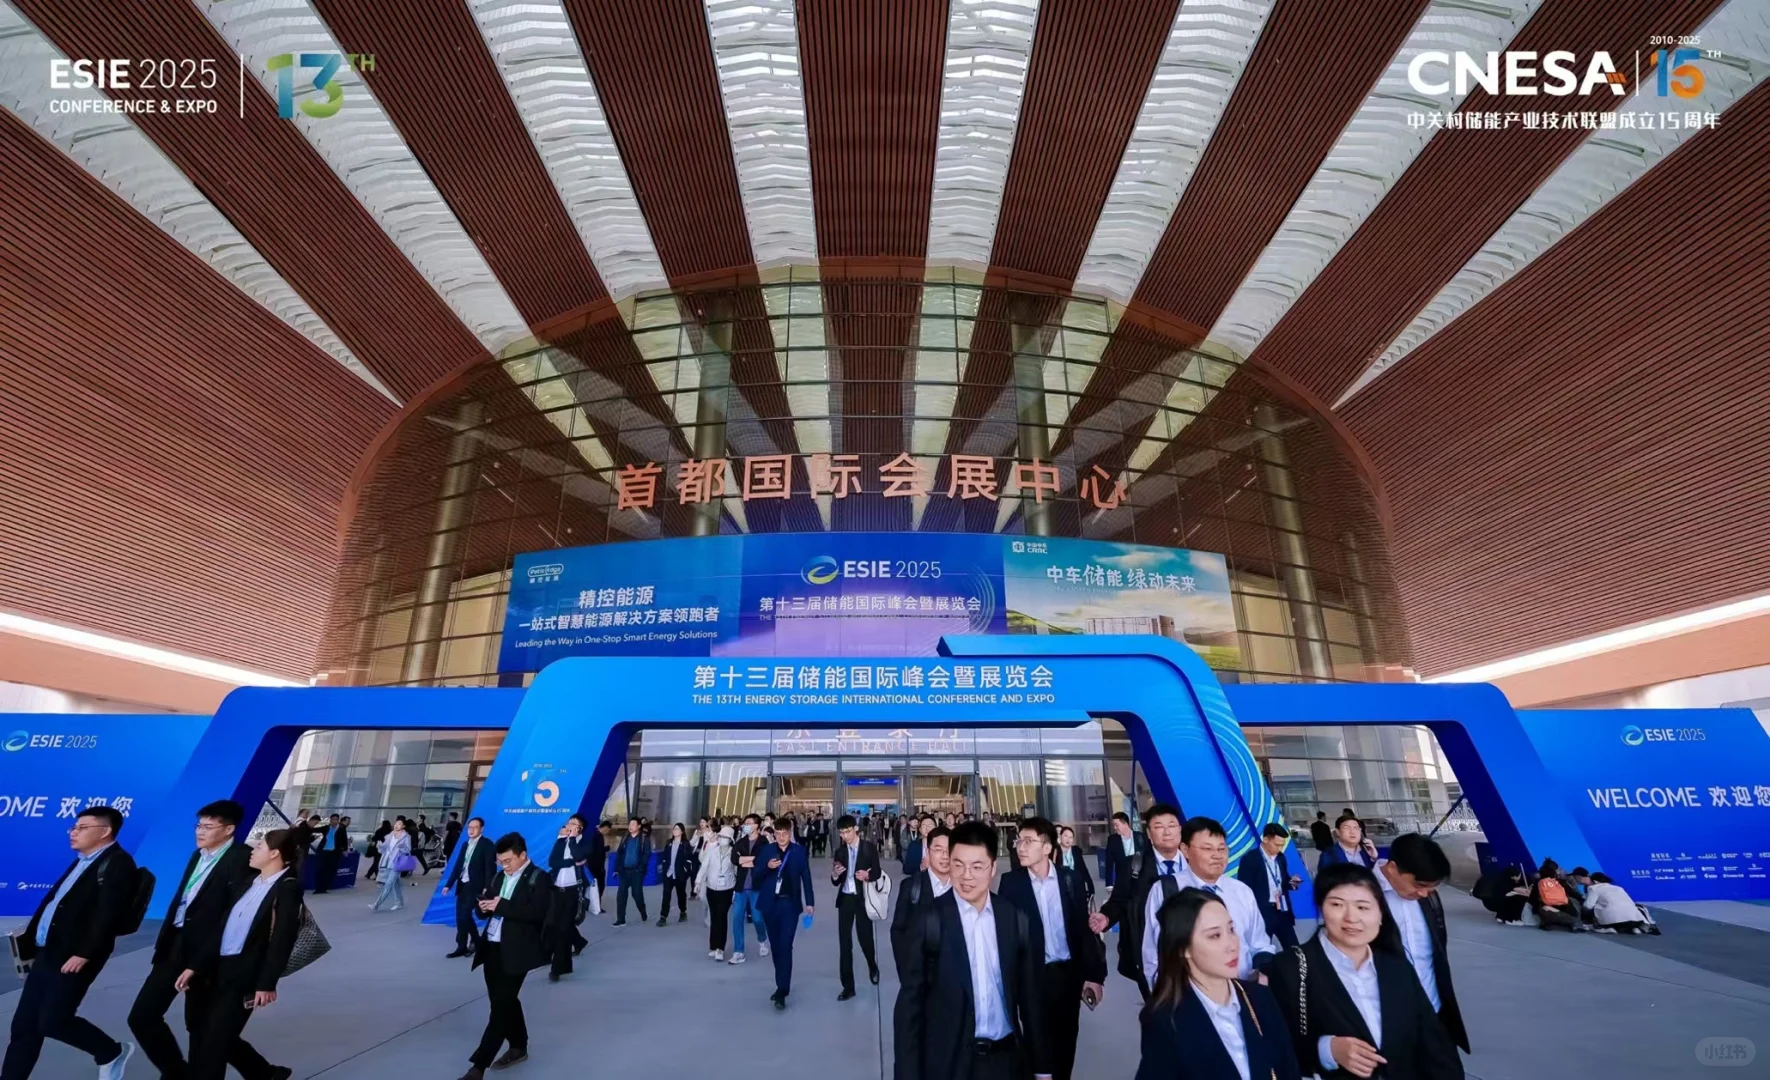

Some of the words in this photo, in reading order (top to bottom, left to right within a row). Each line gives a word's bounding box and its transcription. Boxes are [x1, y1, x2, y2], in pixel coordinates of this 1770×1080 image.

[616, 452, 1128, 511] 首都国际会展中心
[844, 560, 891, 578] ESIE
[896, 560, 941, 579] 2025
[1046, 564, 1123, 588] 中车储能
[1127, 568, 1196, 592] 绿动未来
[578, 585, 655, 609] 精控能源
[759, 596, 981, 612] 第十三届储能国际峰会暨展览会
[518, 606, 720, 632] 一站式智慧能源解决方案领跑者
[515, 639, 543, 648] Leading
[544, 637, 557, 646] the
[558, 637, 574, 646] Way
[575, 636, 583, 644] in
[584, 635, 621, 644] One-Stop
[623, 633, 647, 642] Smart
[648, 632, 677, 642] Energy
[679, 630, 718, 639] Solutions
[693, 665, 1053, 689] 第十三届储能国际峰会暨展览会
[692, 695, 712, 704] THE
[716, 695, 741, 704] 13TH
[745, 695, 786, 704] ENERGY
[789, 695, 838, 704] STORAGE
[842, 694, 924, 704] INTERNATIONAL
[928, 694, 997, 704] CONFERENCE
[1000, 694, 1023, 703] AND
[1027, 694, 1055, 703] EXPO
[30, 734, 64, 748] ESIE
[65, 735, 98, 748] 2025
[1644, 728, 1676, 741] ESIE
[1676, 728, 1706, 741] 2025
[776, 742, 815, 752] EAST
[827, 741, 919, 751] ENTRANCE
[1587, 787, 1701, 808] WELCOME
